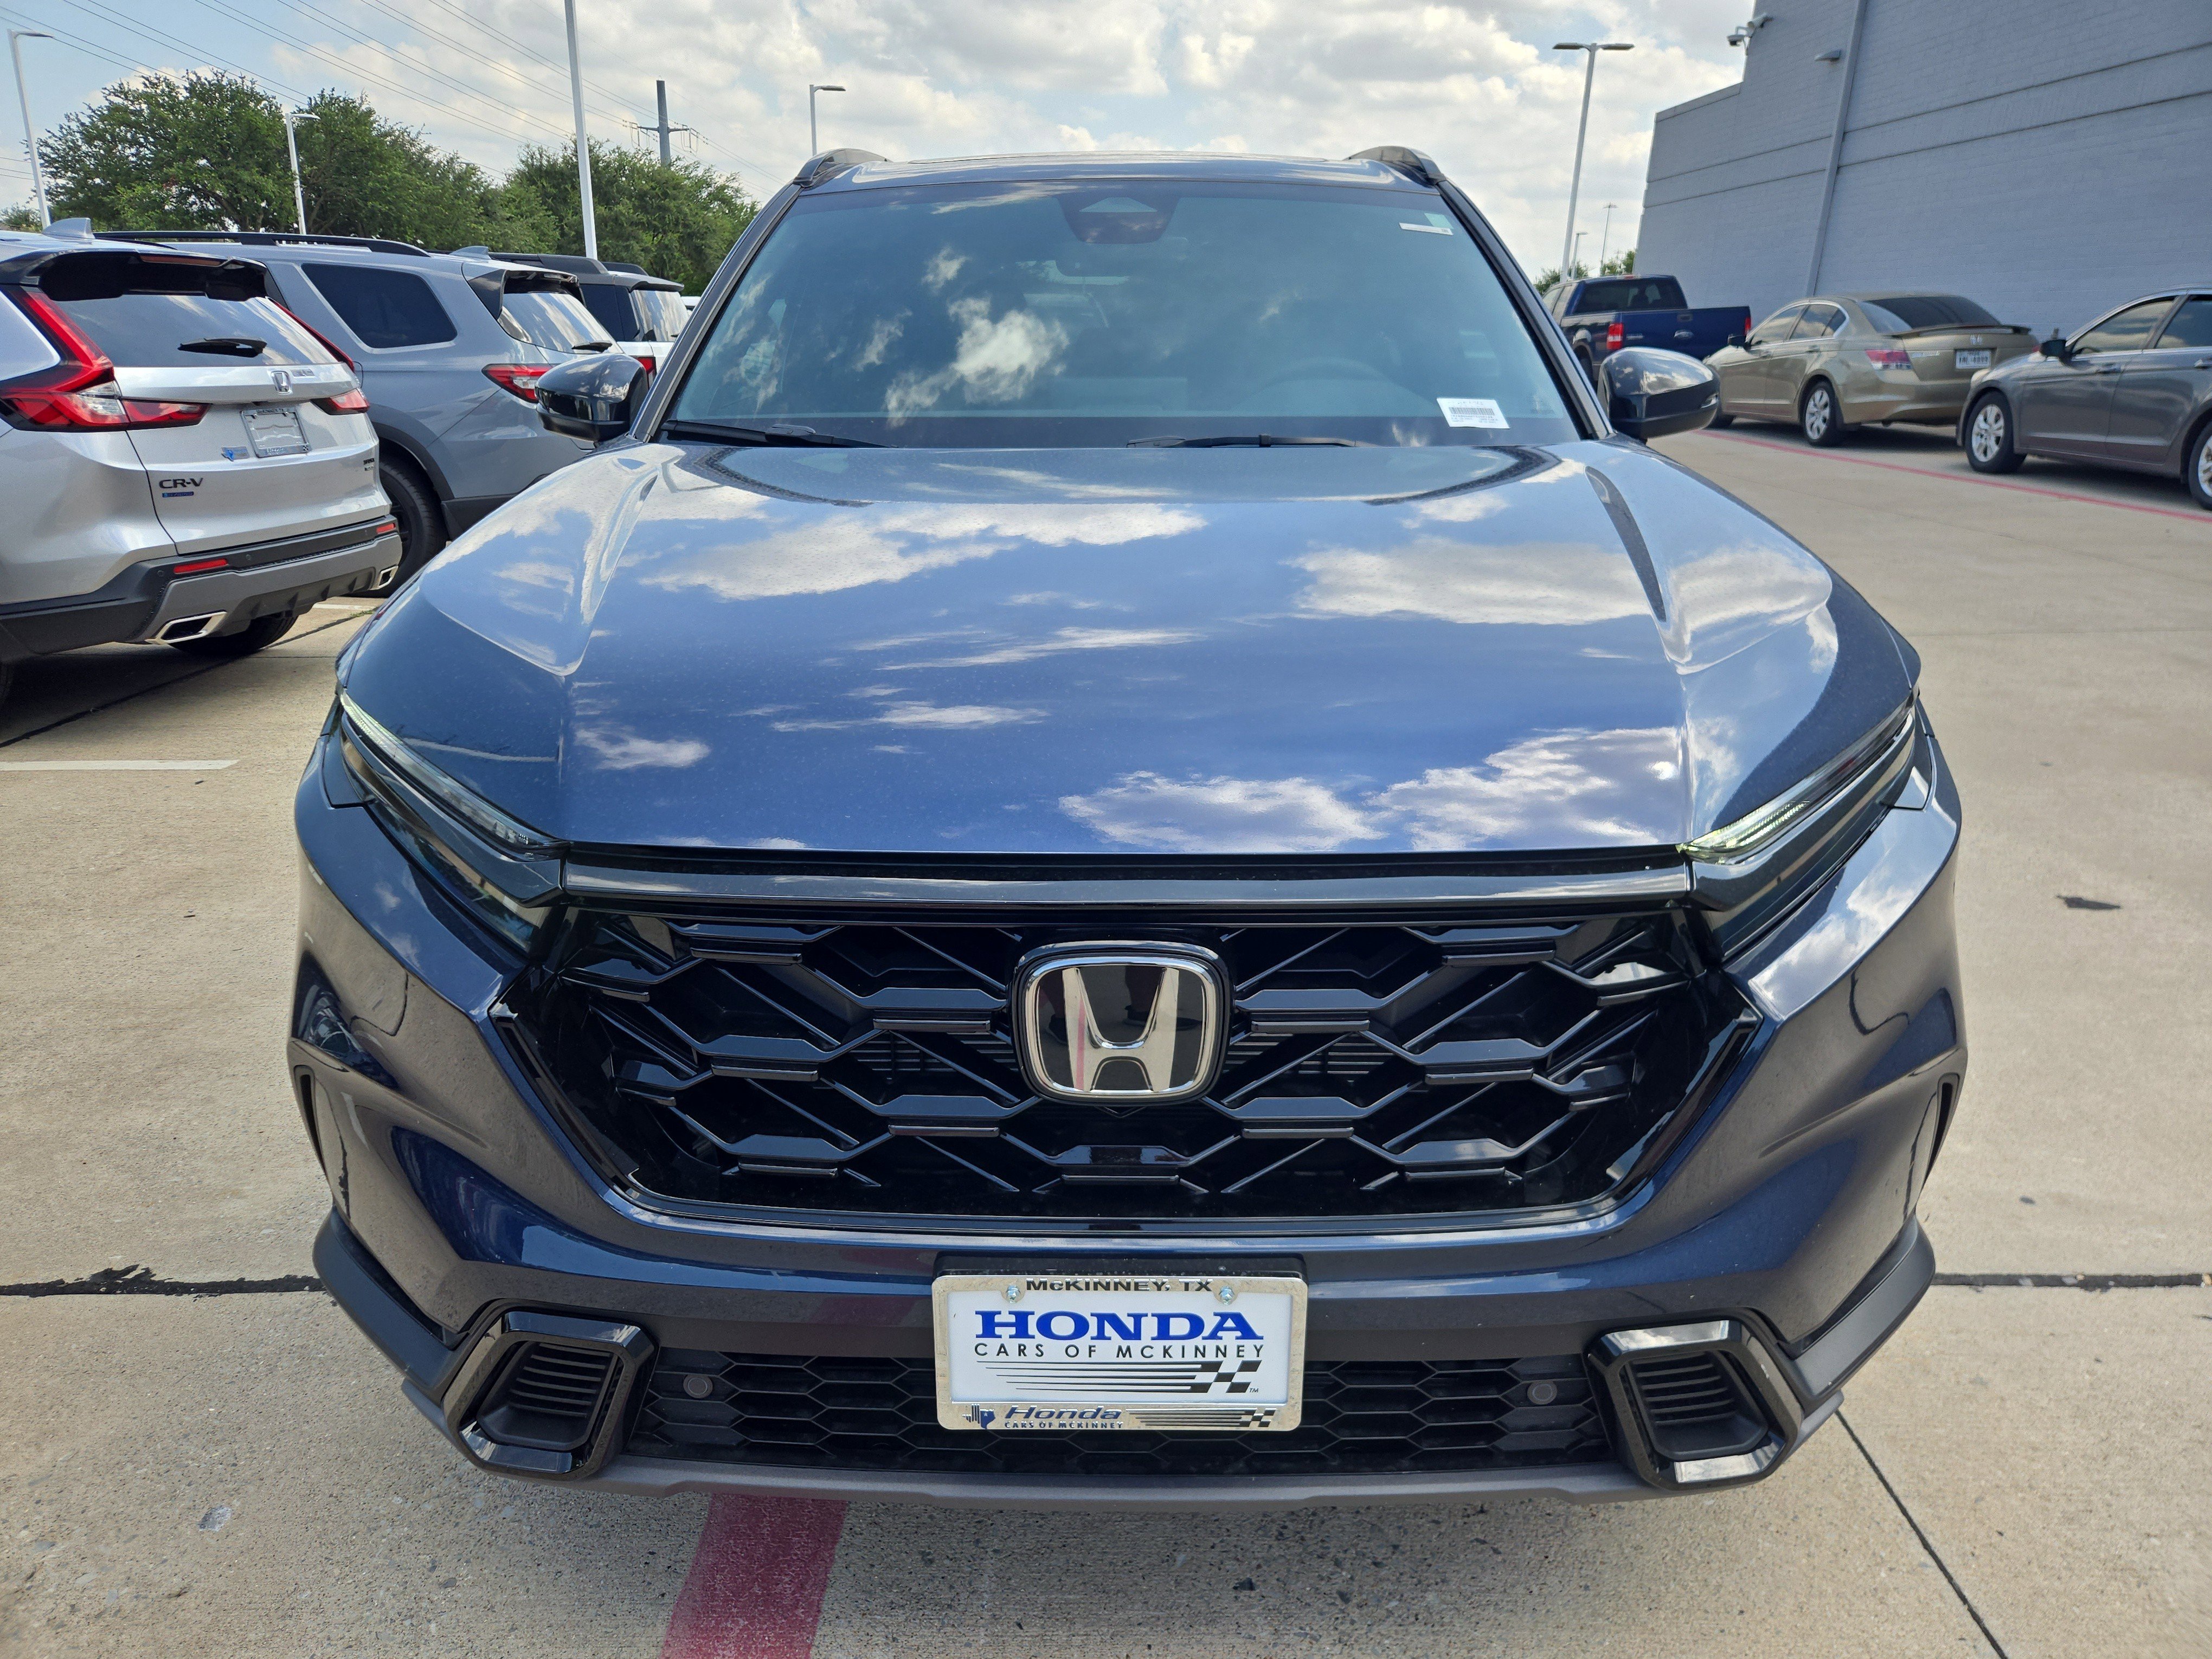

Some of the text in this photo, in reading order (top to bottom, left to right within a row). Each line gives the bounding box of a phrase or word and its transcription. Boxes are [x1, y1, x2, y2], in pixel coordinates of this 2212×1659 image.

[159, 478, 203, 488] CR-V
[1179, 1278, 1213, 1291] TX
[975, 1310, 1264, 1341] HONDA
[974, 1342, 1264, 1359] CARS OF MCKINNEY
[1004, 1405, 1122, 1419] Honda
[1004, 1420, 1124, 1429] CARS OF MCKINNEY
